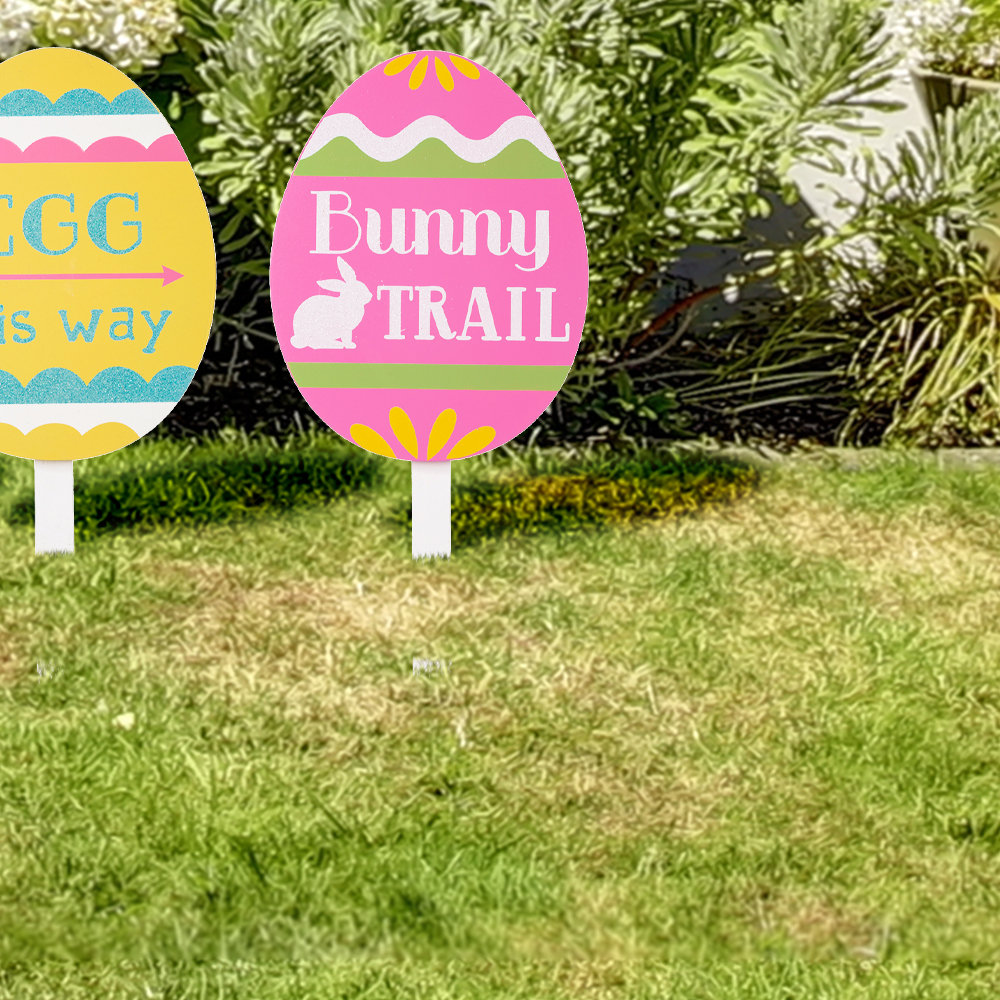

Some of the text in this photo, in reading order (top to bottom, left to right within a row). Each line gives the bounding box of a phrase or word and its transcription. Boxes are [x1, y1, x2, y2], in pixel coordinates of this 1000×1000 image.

[309, 190, 550, 272] Bunny
[58, 306, 173, 353] way
[377, 285, 570, 342] TRAIL
